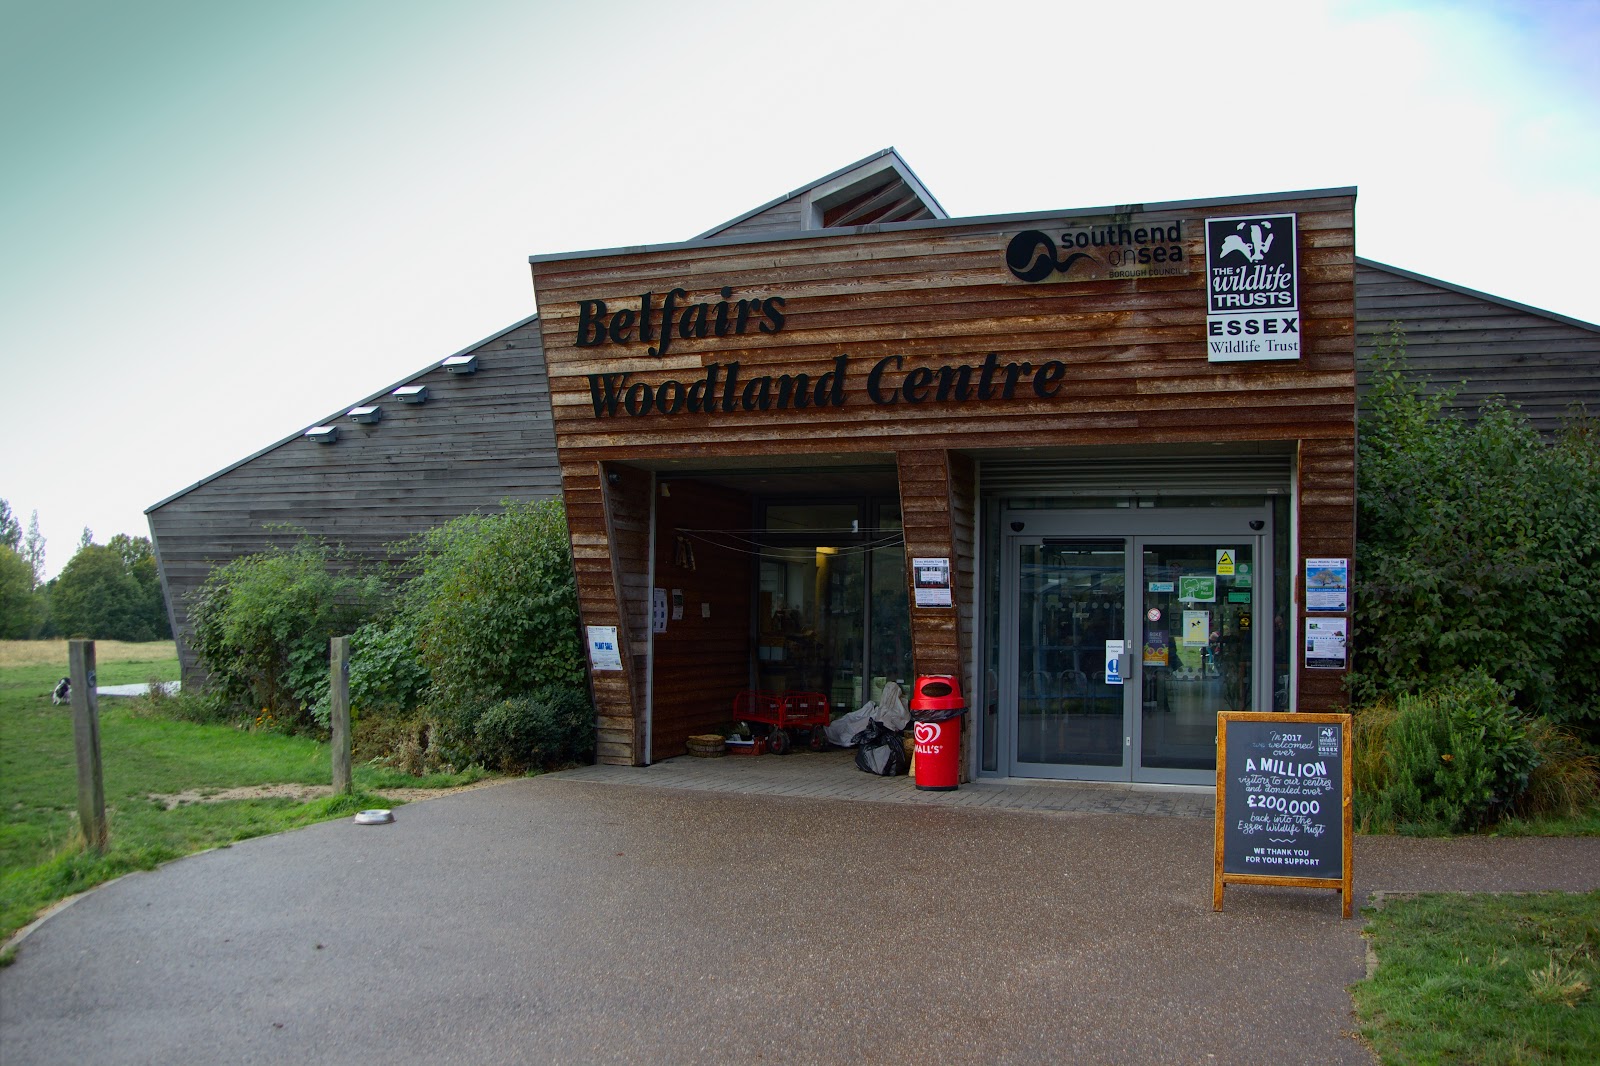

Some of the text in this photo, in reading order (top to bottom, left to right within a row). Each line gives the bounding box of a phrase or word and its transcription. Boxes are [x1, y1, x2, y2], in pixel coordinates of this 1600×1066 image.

[1061, 220, 1181, 249] southend
[1109, 267, 1183, 279] BOROUGH COUNCIL
[1213, 267, 1233, 276] THE
[1213, 263, 1292, 292] wildlife
[1213, 291, 1292, 308] TRUSTS
[575, 286, 786, 358] Belfairs
[1209, 318, 1299, 337] ESSEX
[1209, 339, 1299, 354] Wildlife Trust
[588, 353, 1066, 419] Woodland Centre
[1269, 731, 1302, 742] In 2017
[1268, 740, 1315, 750] welcomed
[1272, 749, 1296, 757] over
[1245, 757, 1328, 778] A MILLION
[1237, 774, 1334, 791] visitors to our centres
[1245, 783, 1323, 796] and donated over
[1246, 794, 1320, 815] £200,000
[1250, 812, 1313, 825] back into the
[1237, 820, 1327, 838] Essex Wildlife Trust
[1253, 847, 1310, 857] WE THANK YOU
[1284, 858, 1320, 866] SUPPORT
